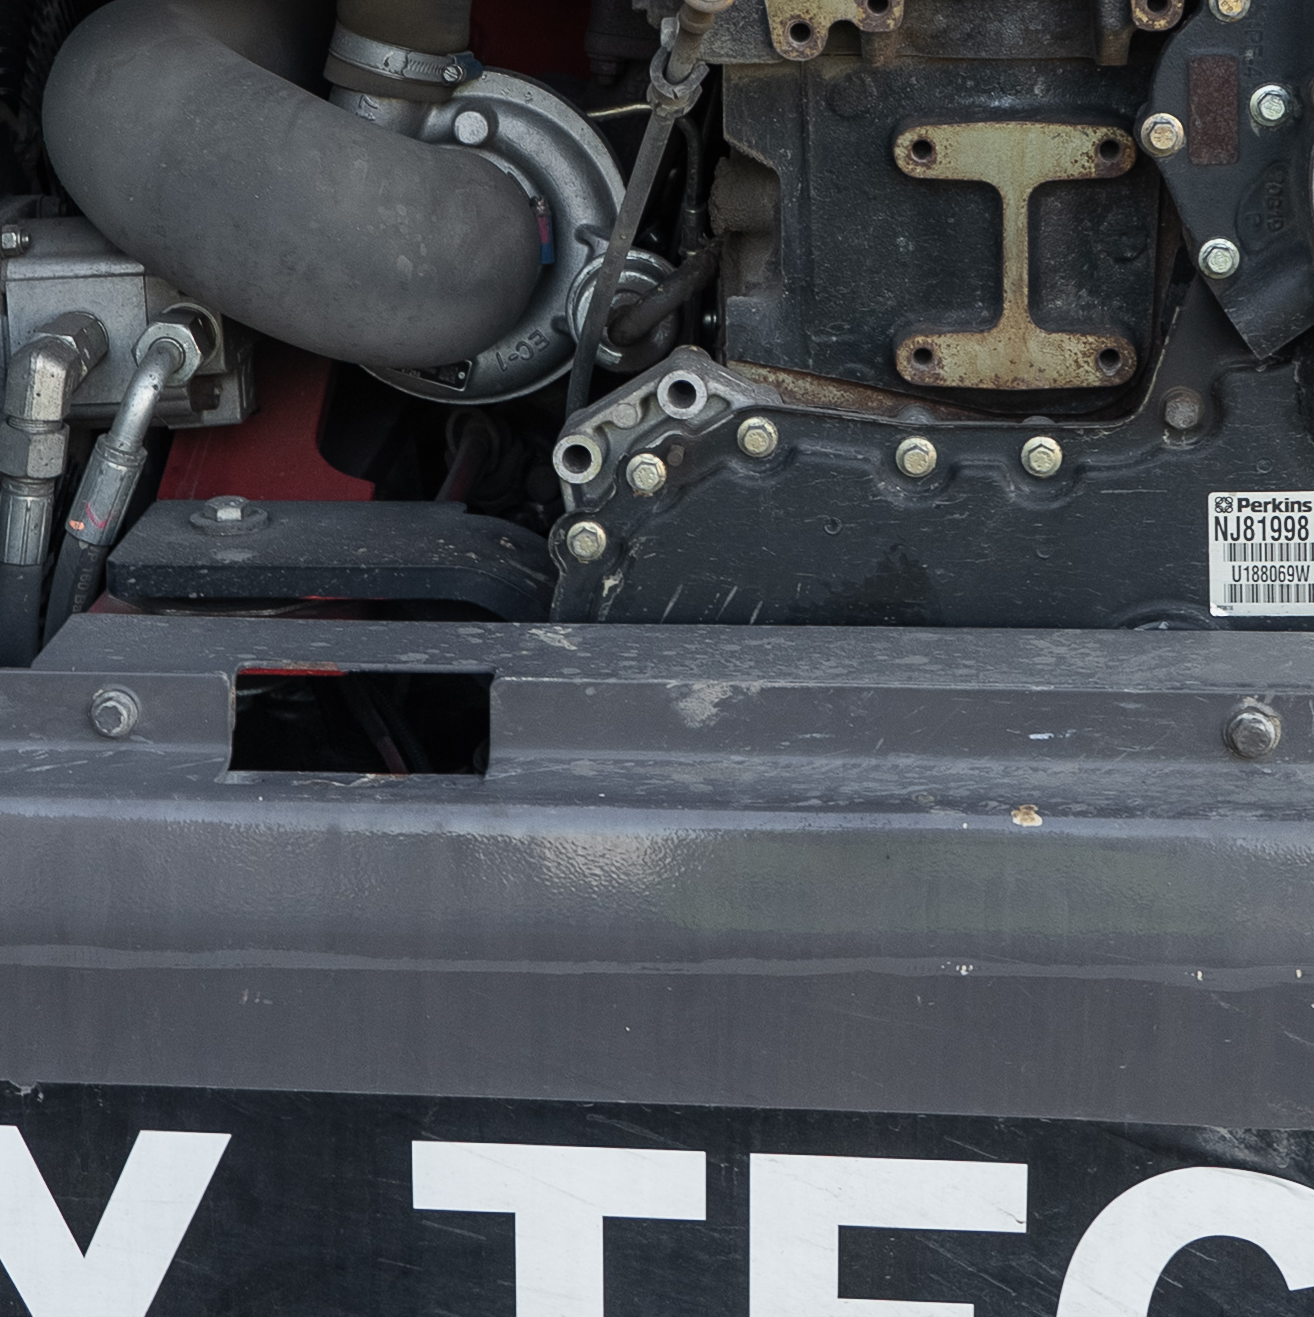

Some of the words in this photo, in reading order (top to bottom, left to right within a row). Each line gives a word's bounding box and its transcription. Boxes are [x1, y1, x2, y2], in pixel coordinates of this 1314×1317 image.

[494, 329, 551, 372] EC-1
[1237, 497, 1313, 513] Perkins
[1214, 515, 1310, 542] NJ81998
[77, 568, 94, 590] 160
[1232, 564, 1311, 583] U188069W
